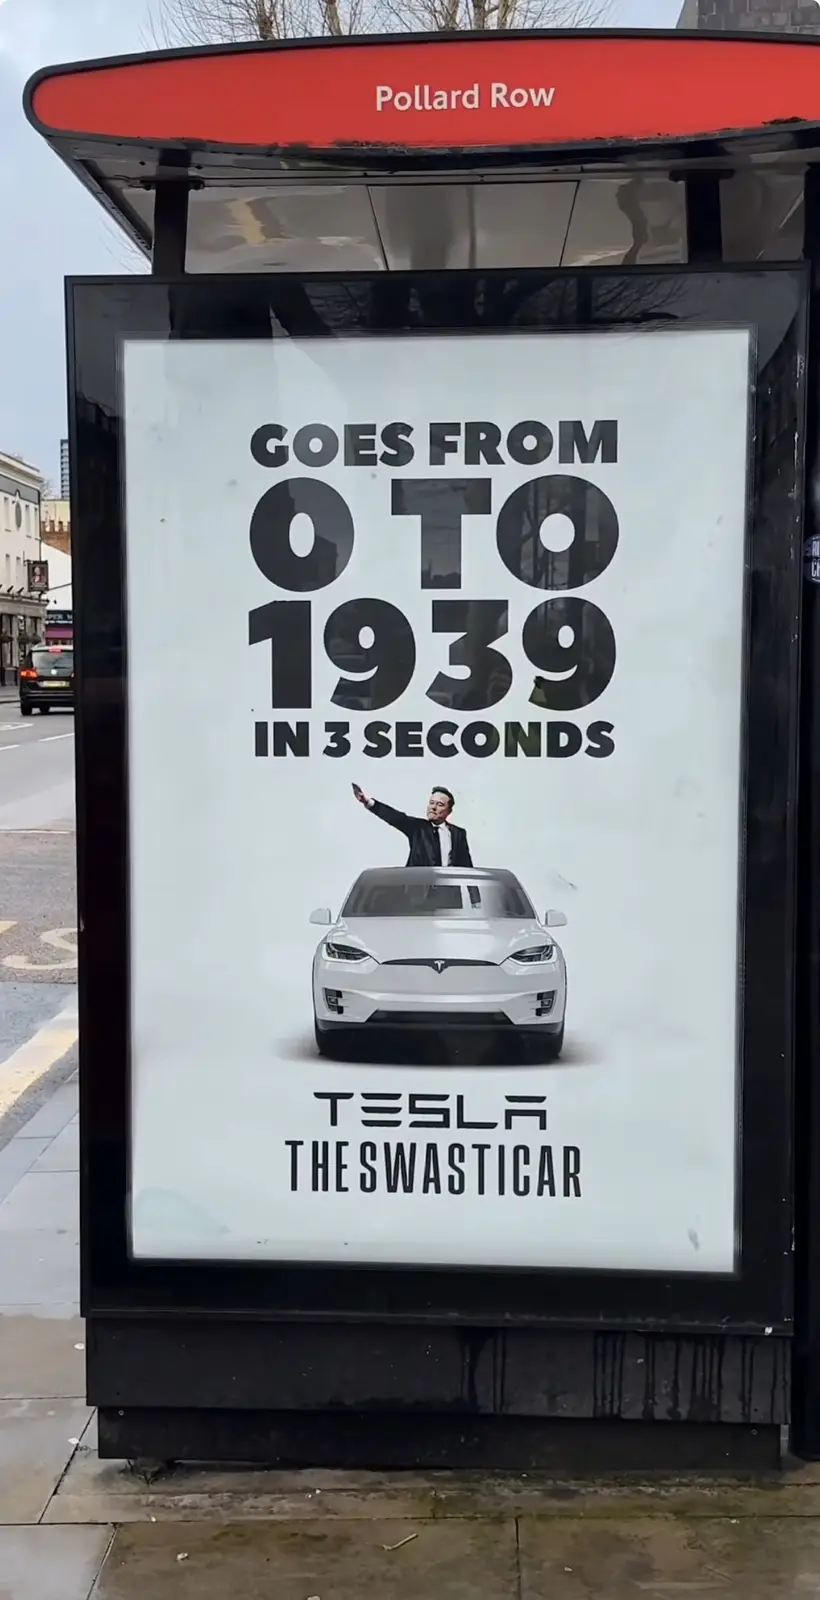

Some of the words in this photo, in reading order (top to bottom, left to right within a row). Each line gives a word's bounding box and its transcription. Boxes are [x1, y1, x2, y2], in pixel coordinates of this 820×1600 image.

[376, 82, 479, 111] Pollard
[491, 82, 555, 109] Row
[250, 421, 415, 468] GOES
[429, 419, 618, 466] FROM
[249, 476, 355, 593] 0
[390, 473, 620, 591] TO
[248, 596, 617, 712] 1939
[254, 721, 310, 758] IN
[322, 721, 351, 758] 3
[363, 720, 615, 759] SECONDS
[313, 1091, 547, 1131] TESLA
[284, 1140, 350, 1194] THE
[360, 1140, 582, 1198] SWASTICAR
